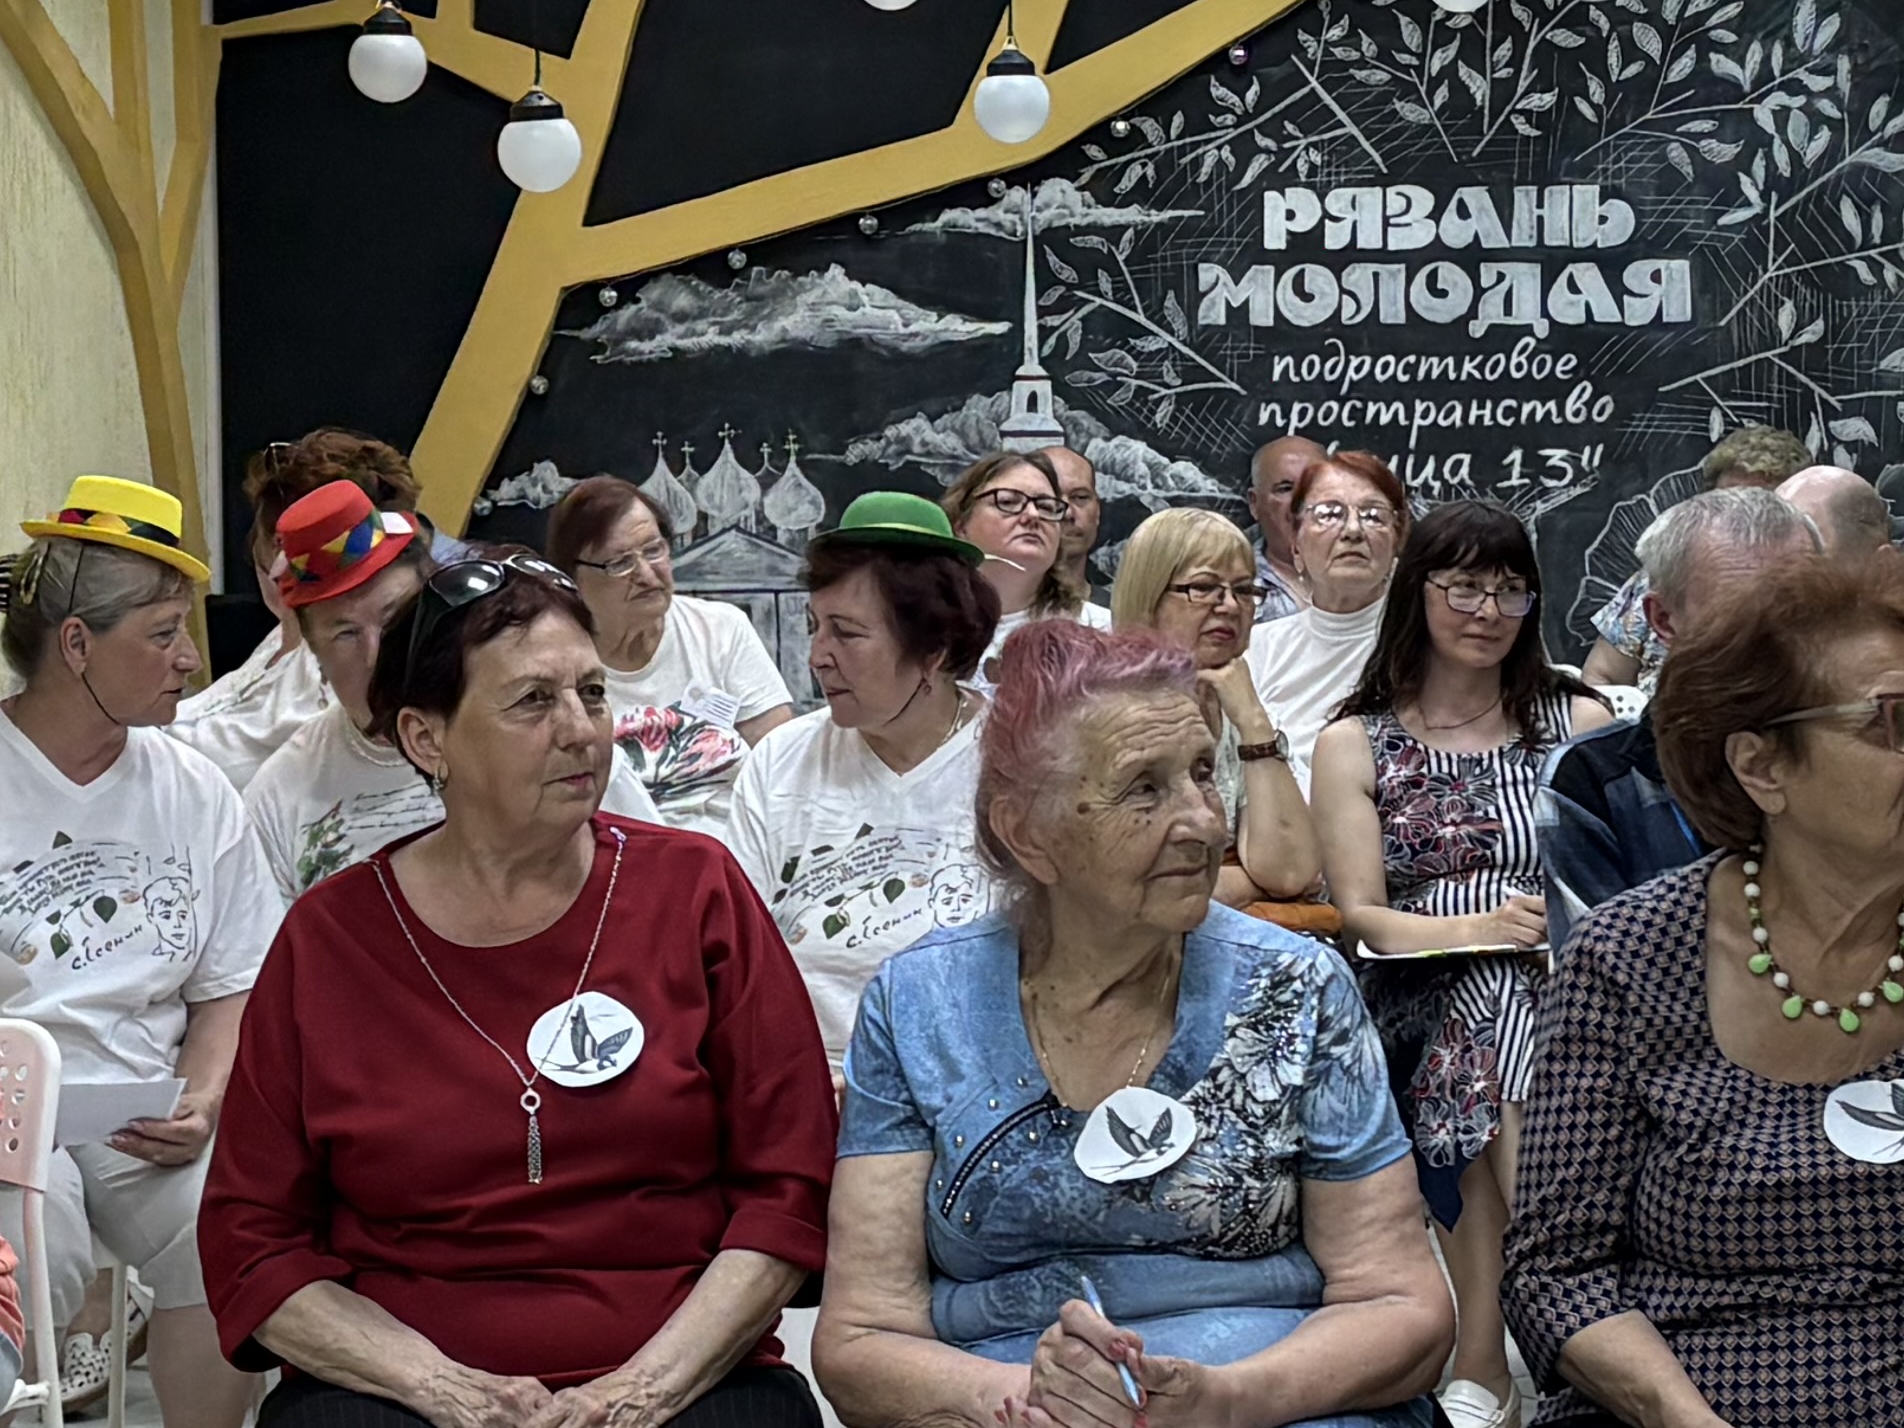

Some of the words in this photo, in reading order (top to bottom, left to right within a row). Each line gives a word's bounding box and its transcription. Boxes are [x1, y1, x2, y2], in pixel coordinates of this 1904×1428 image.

[1262, 184, 1636, 251] РЯЗАНЬ
[1197, 258, 1693, 339] МОЛОДАЯ
[1271, 335, 1579, 396] подростковое
[1257, 380, 1616, 449] пространство
